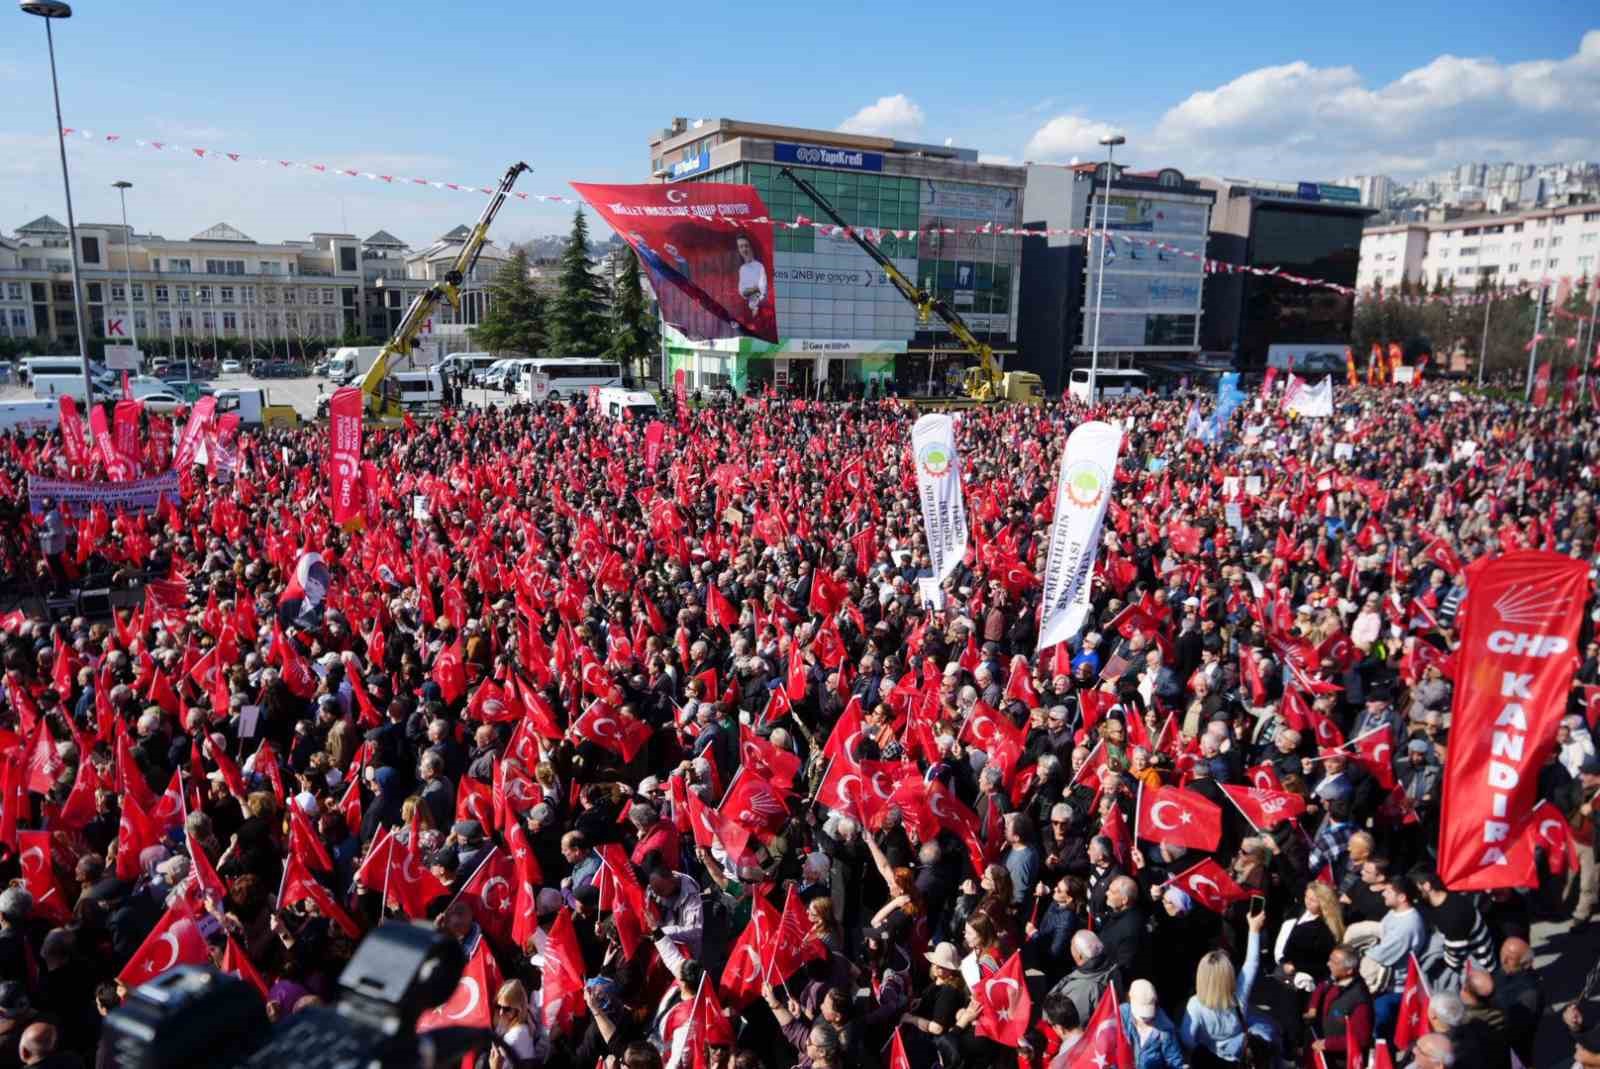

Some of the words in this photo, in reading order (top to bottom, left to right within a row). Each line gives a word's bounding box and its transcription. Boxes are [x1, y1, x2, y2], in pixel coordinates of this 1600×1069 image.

[341, 479, 351, 508] CHP
[1486, 630, 1569, 657] CHP
[1481, 670, 1534, 866] KANDIRA
